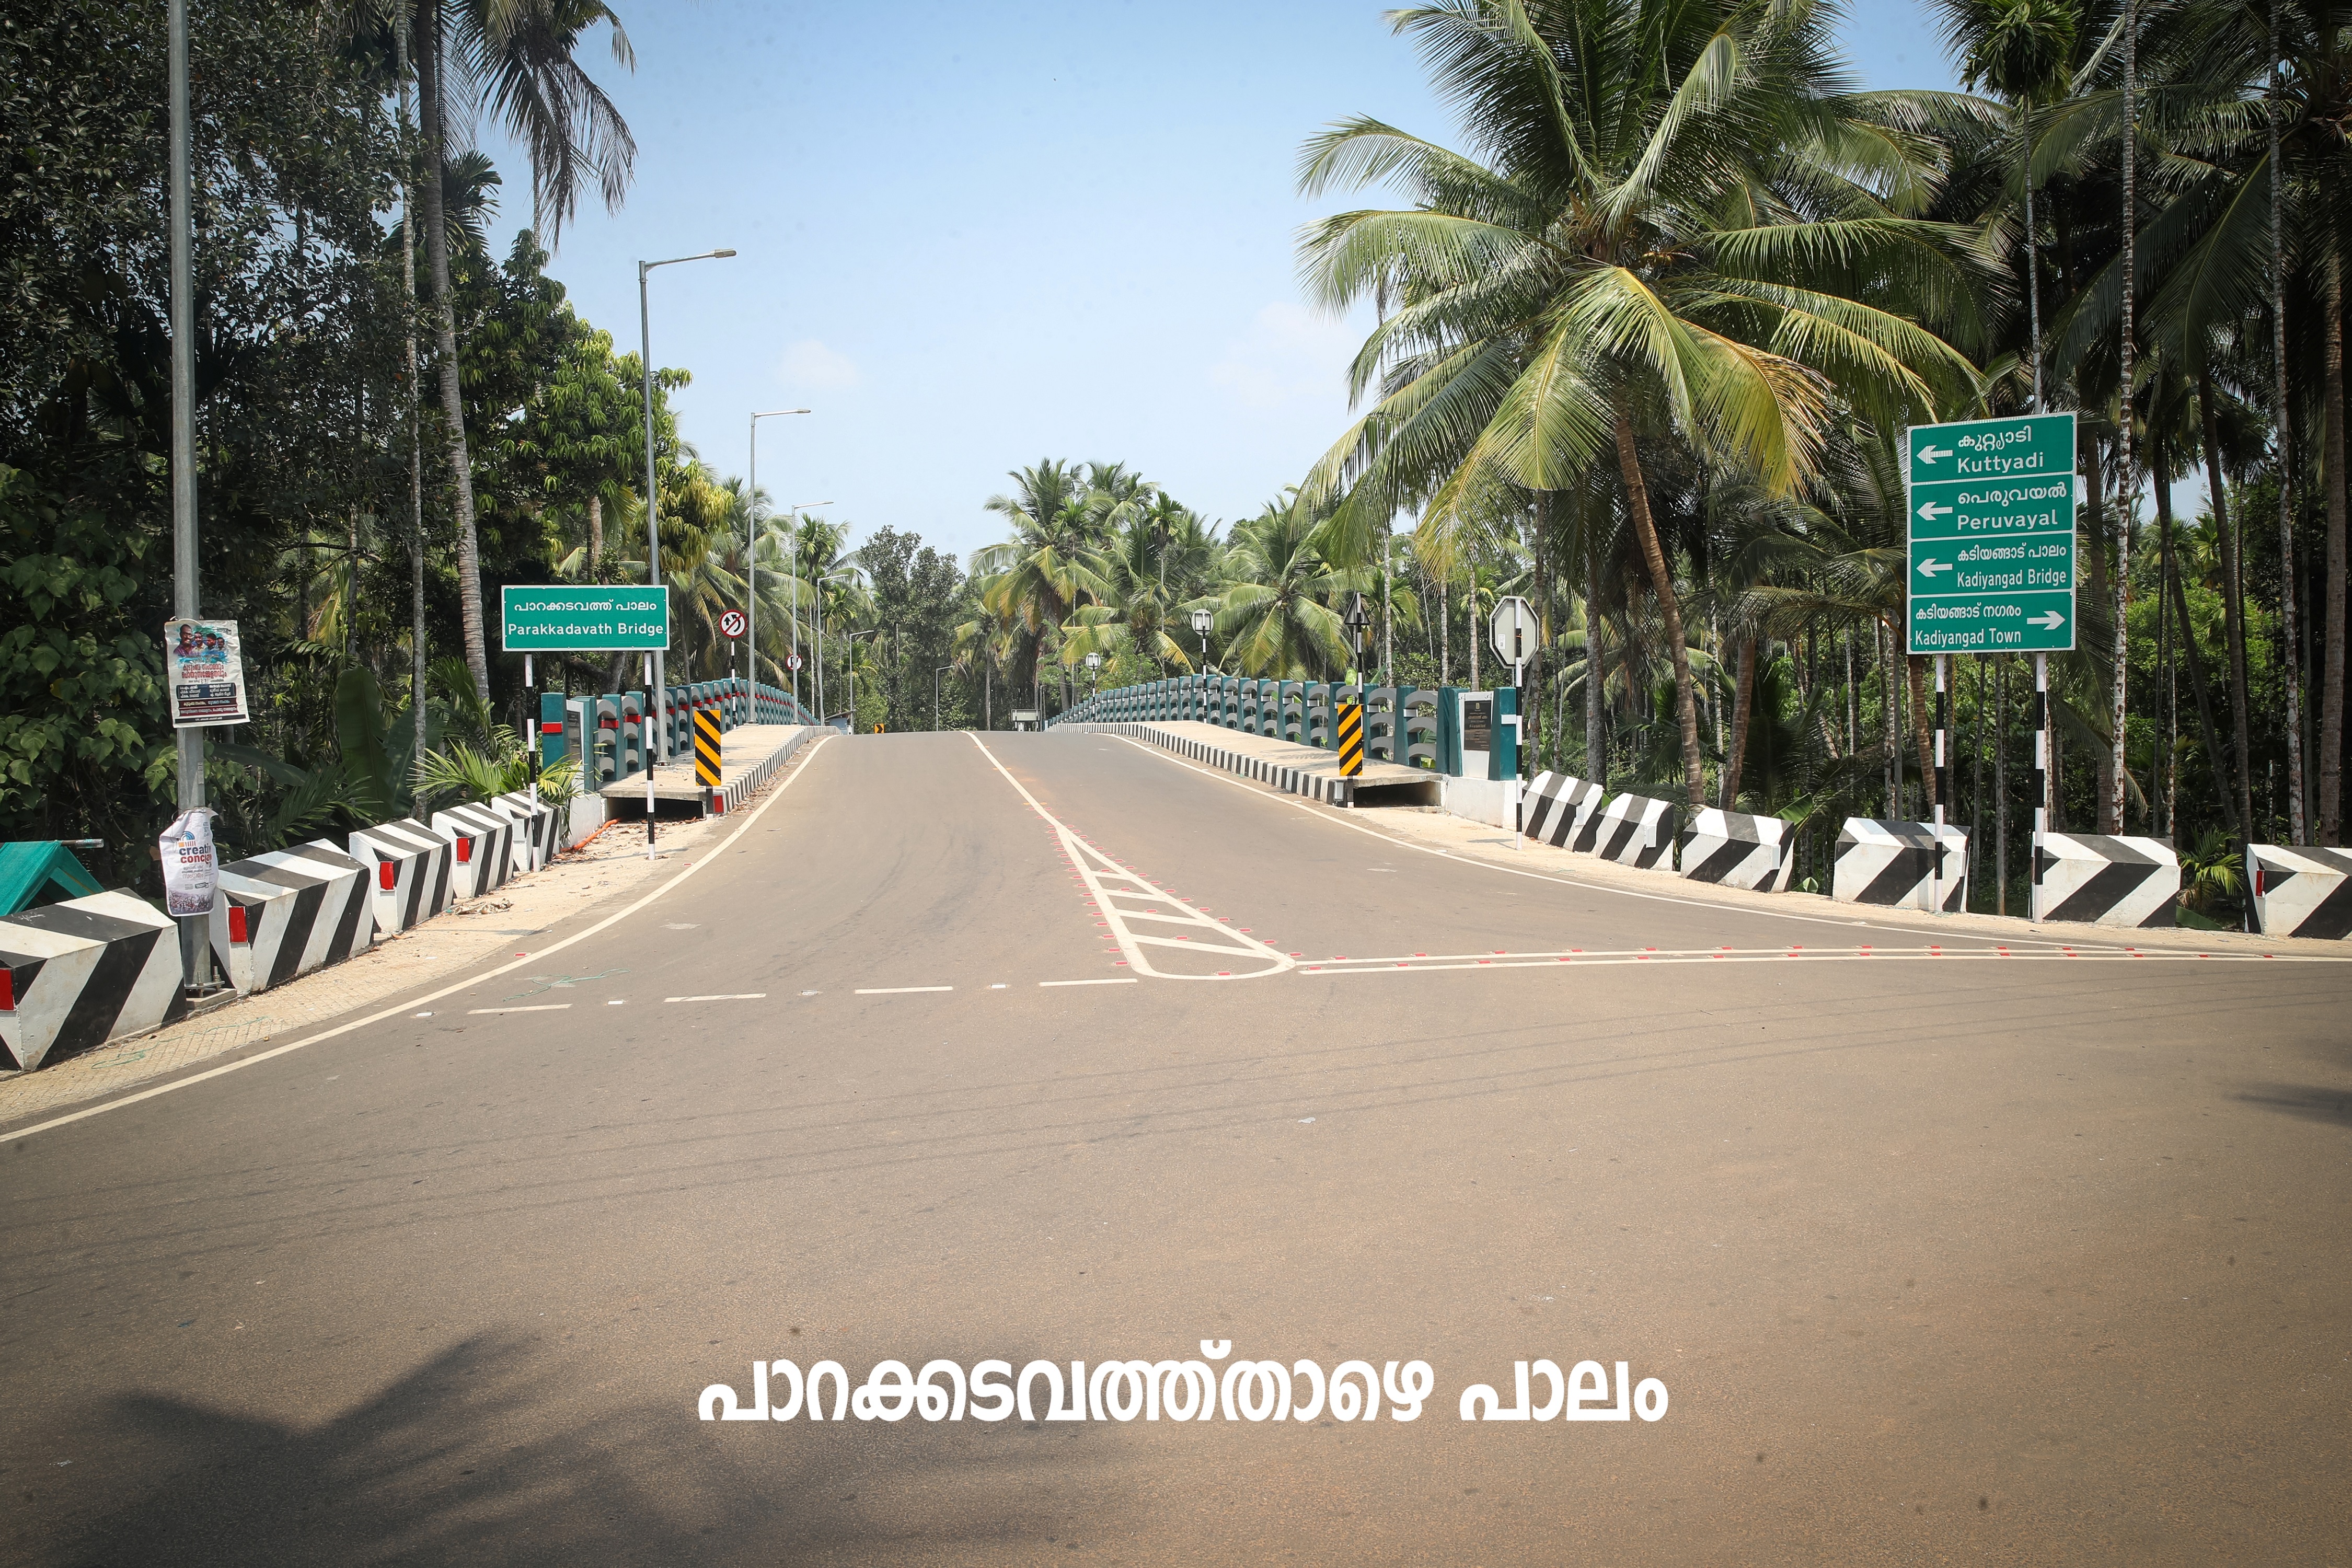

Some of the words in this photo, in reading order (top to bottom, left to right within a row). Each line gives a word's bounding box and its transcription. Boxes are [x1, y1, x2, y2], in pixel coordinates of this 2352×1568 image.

[1958, 425, 2032, 452] കുറ്റ്യാടി
[1958, 452, 2043, 473] Kuttyadi
[1958, 481, 2067, 507] പെരുവയൽ
[1958, 509, 2058, 530] Peruvayal
[1958, 542, 2026, 561] കടിയങ്ങാട്
[2028, 545, 2067, 558] പാലം
[1957, 569, 2022, 590] Kadiyangad
[2028, 568, 2066, 586] Bridge
[514, 598, 614, 611] പാറക്കടവത്ത്
[616, 602, 657, 610] പാലം
[1916, 602, 1981, 620] കടിയങ്ങാട്
[1983, 605, 2021, 617] നഗരം
[508, 623, 612, 635] Parakkadavath
[618, 622, 663, 637] Bridge
[1916, 629, 1984, 648] Kadiyangad
[1989, 628, 2021, 643] Town
